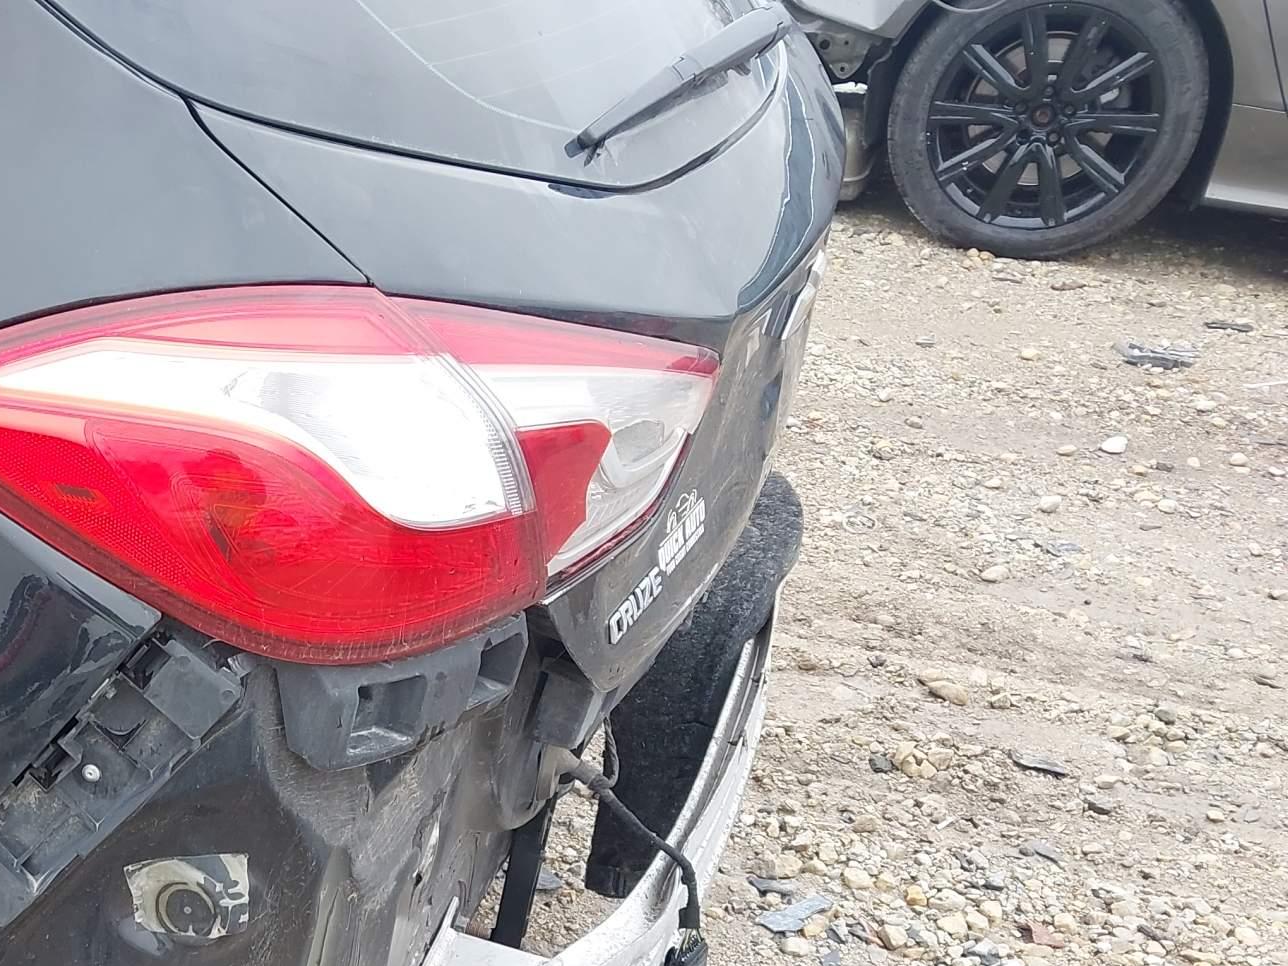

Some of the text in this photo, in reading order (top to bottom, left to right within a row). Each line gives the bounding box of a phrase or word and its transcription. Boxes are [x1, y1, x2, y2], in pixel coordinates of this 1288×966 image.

[658, 523, 685, 572] QUICK
[685, 499, 706, 536] AUTO
[609, 566, 663, 645] CRUZE
